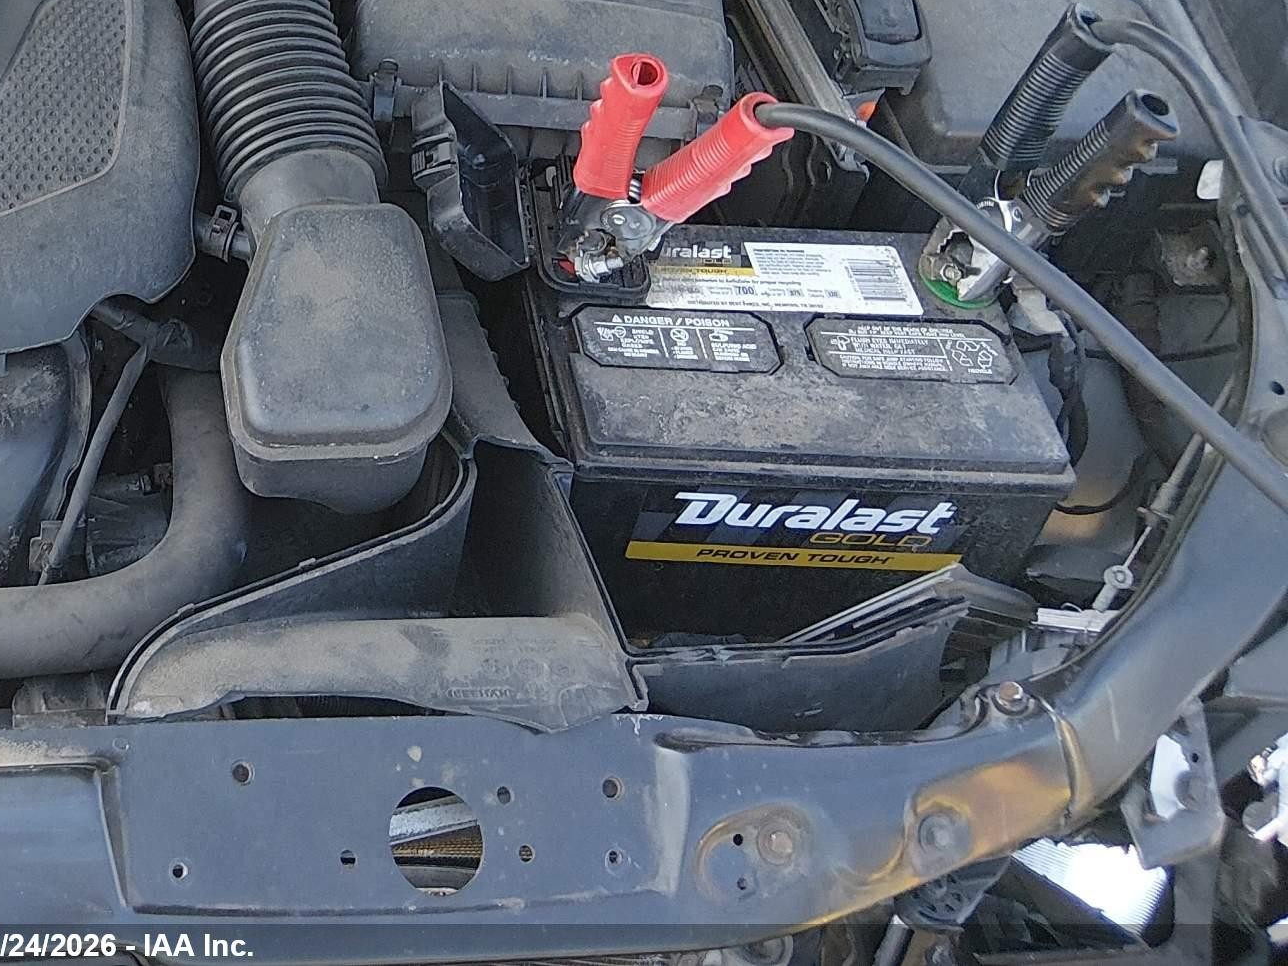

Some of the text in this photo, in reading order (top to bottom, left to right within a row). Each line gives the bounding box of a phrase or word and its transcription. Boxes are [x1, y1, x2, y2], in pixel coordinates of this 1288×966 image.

[661, 244, 732, 259] uralast
[737, 286, 755, 296] 700
[624, 315, 673, 326] DANGER
[685, 318, 730, 327] POISON
[674, 491, 956, 534] Duralast
[809, 532, 933, 549] GOLD
[696, 548, 892, 565] PROVEN TOUGH
